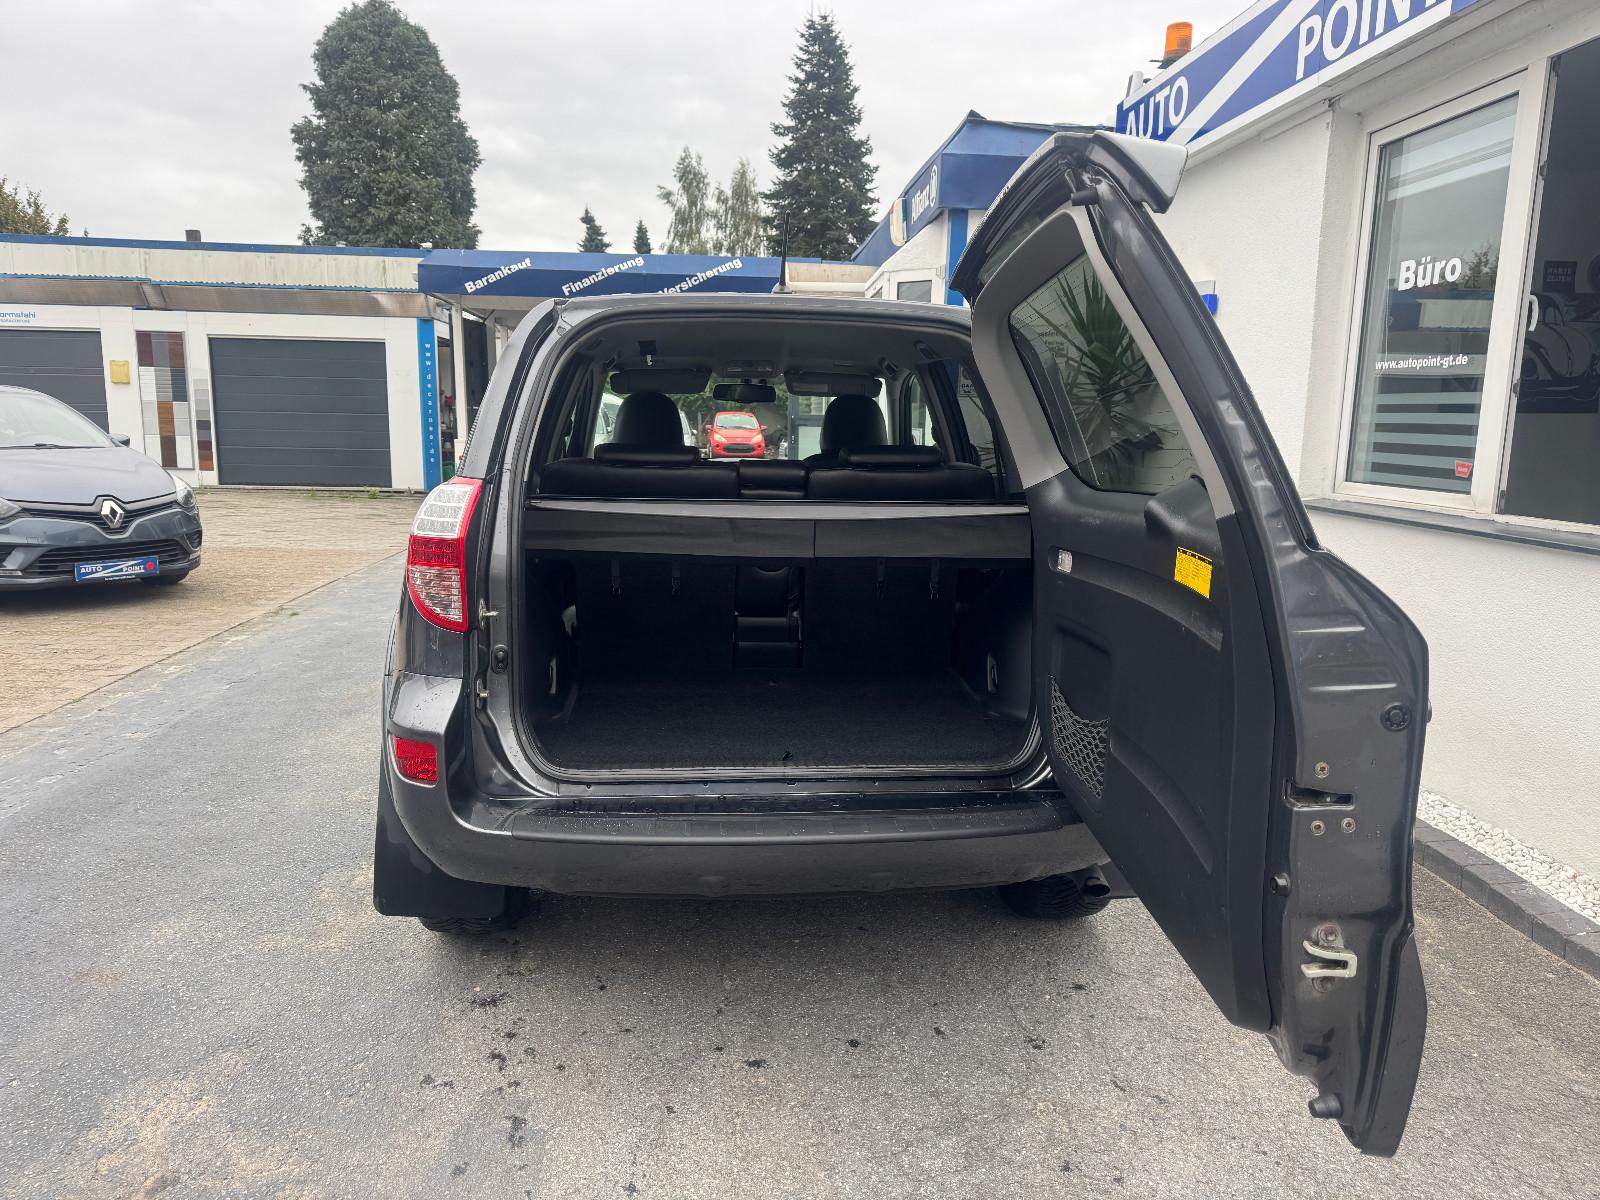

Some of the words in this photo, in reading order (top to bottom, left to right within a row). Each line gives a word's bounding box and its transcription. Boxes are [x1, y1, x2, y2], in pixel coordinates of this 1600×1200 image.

[1126, 76, 1188, 140] AUTO
[1296, 0, 1437, 81] POIN
[912, 184, 930, 224] Allianz
[464, 257, 532, 294] Barankauf
[561, 256, 645, 296] Finanzierung
[1398, 256, 1462, 291] Büro
[1375, 353, 1468, 370] www.autopoint-gt.de
